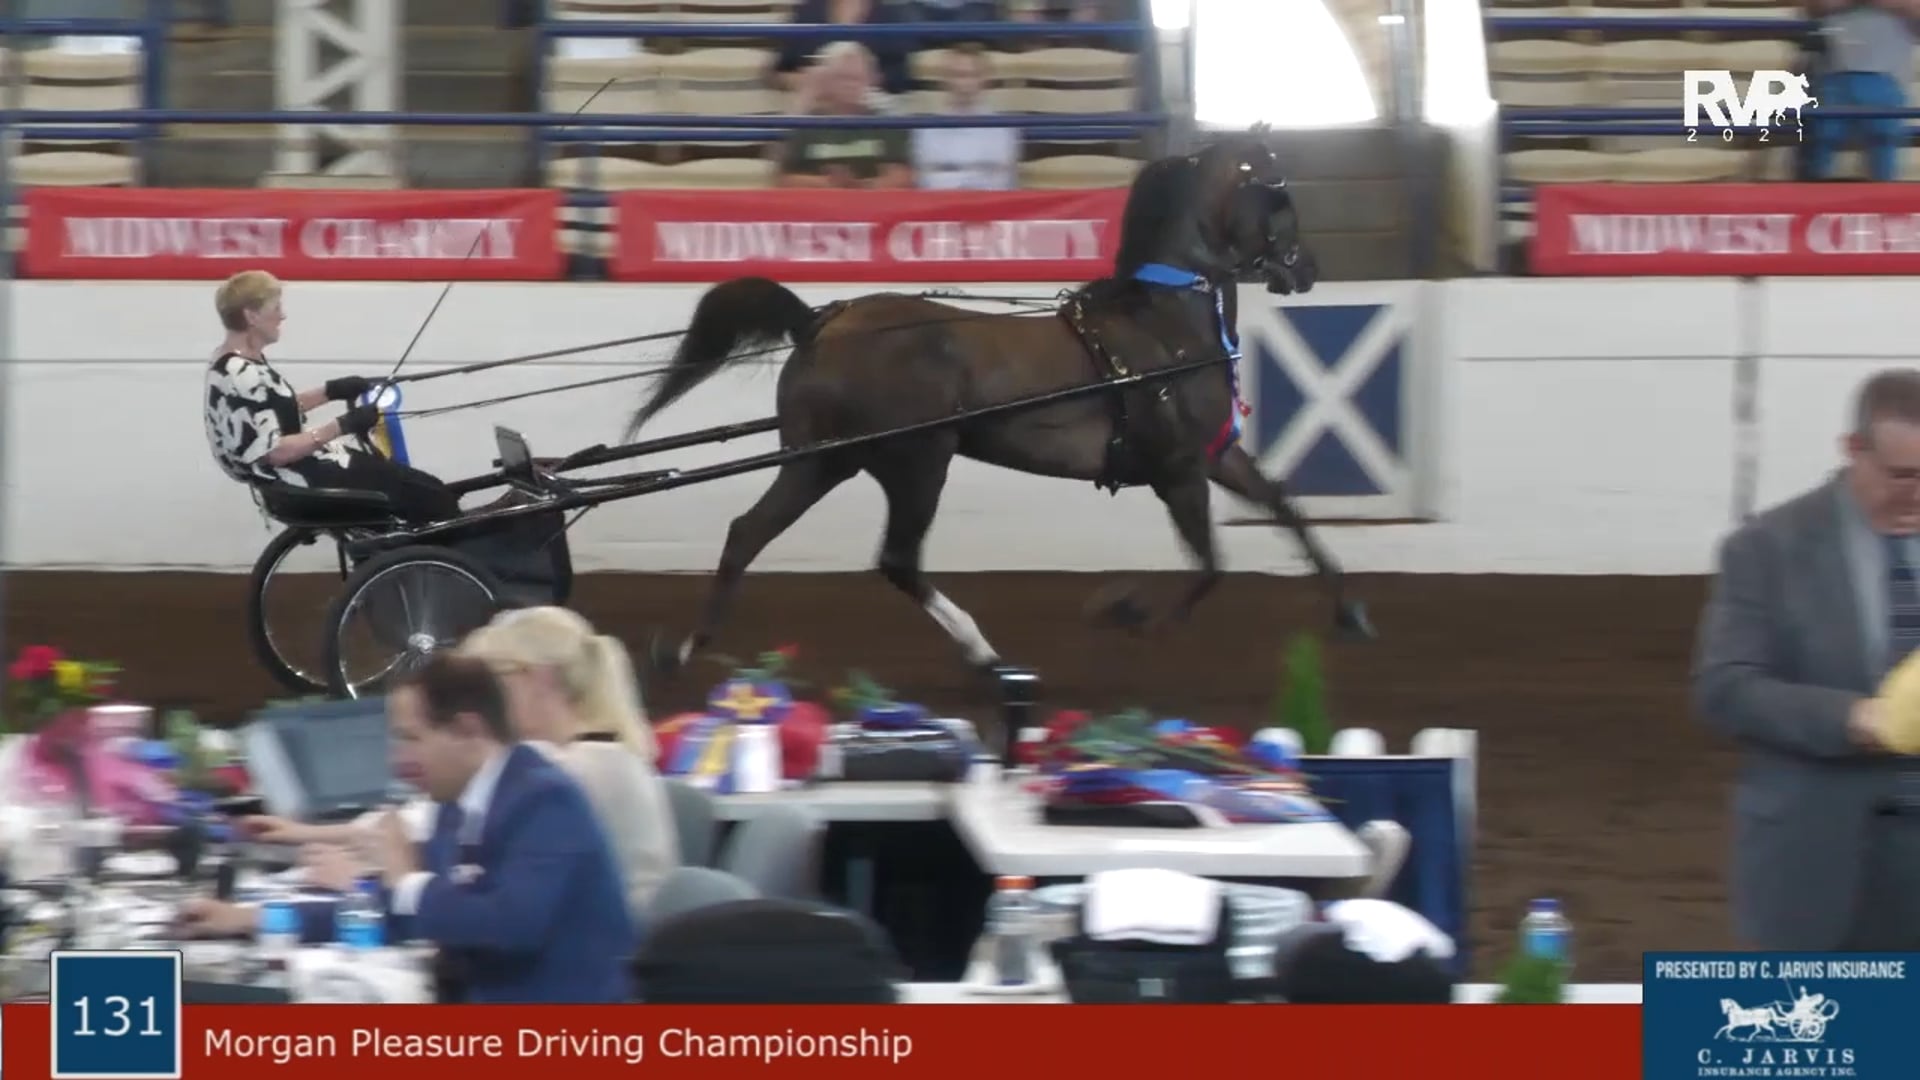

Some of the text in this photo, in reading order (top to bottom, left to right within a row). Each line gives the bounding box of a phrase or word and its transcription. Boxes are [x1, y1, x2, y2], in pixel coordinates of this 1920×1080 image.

[61, 216, 523, 260] MIDWEST CHARITY
[653, 219, 1107, 262] MIDWEST CHARITY
[1569, 213, 1920, 254] MIDWEST CHA
